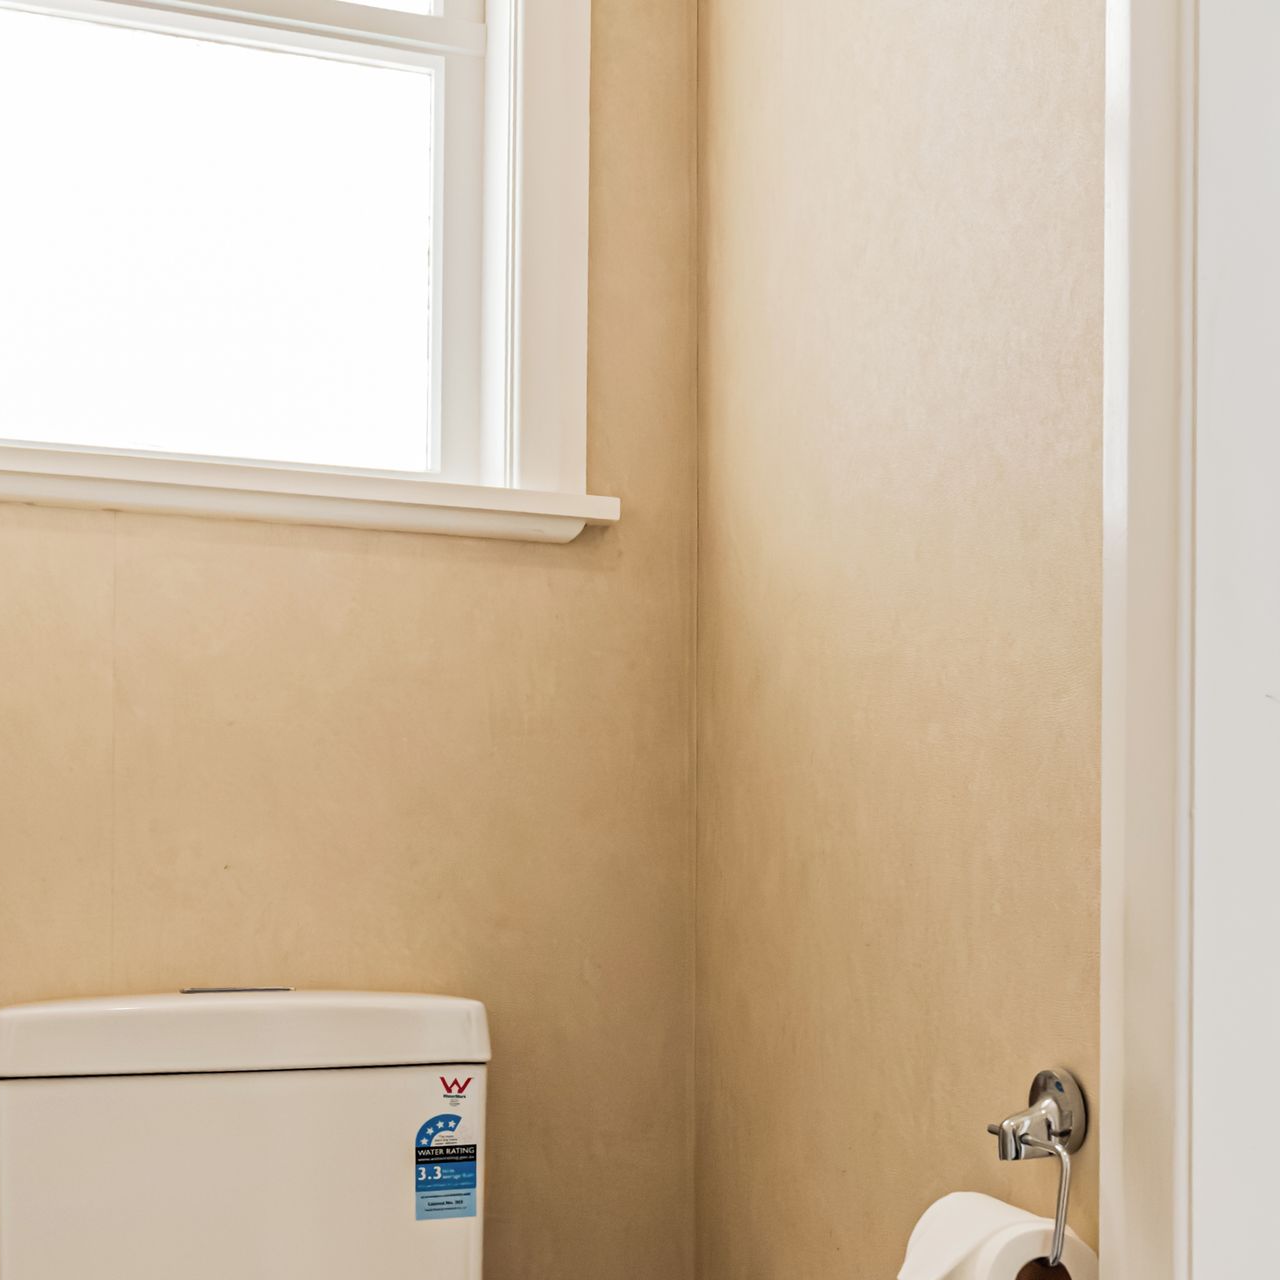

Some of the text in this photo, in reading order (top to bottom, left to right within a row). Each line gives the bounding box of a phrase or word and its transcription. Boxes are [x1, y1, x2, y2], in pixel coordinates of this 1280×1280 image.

[418, 1146, 475, 1156] WATER RATING
[418, 1166, 442, 1181] 3.3
